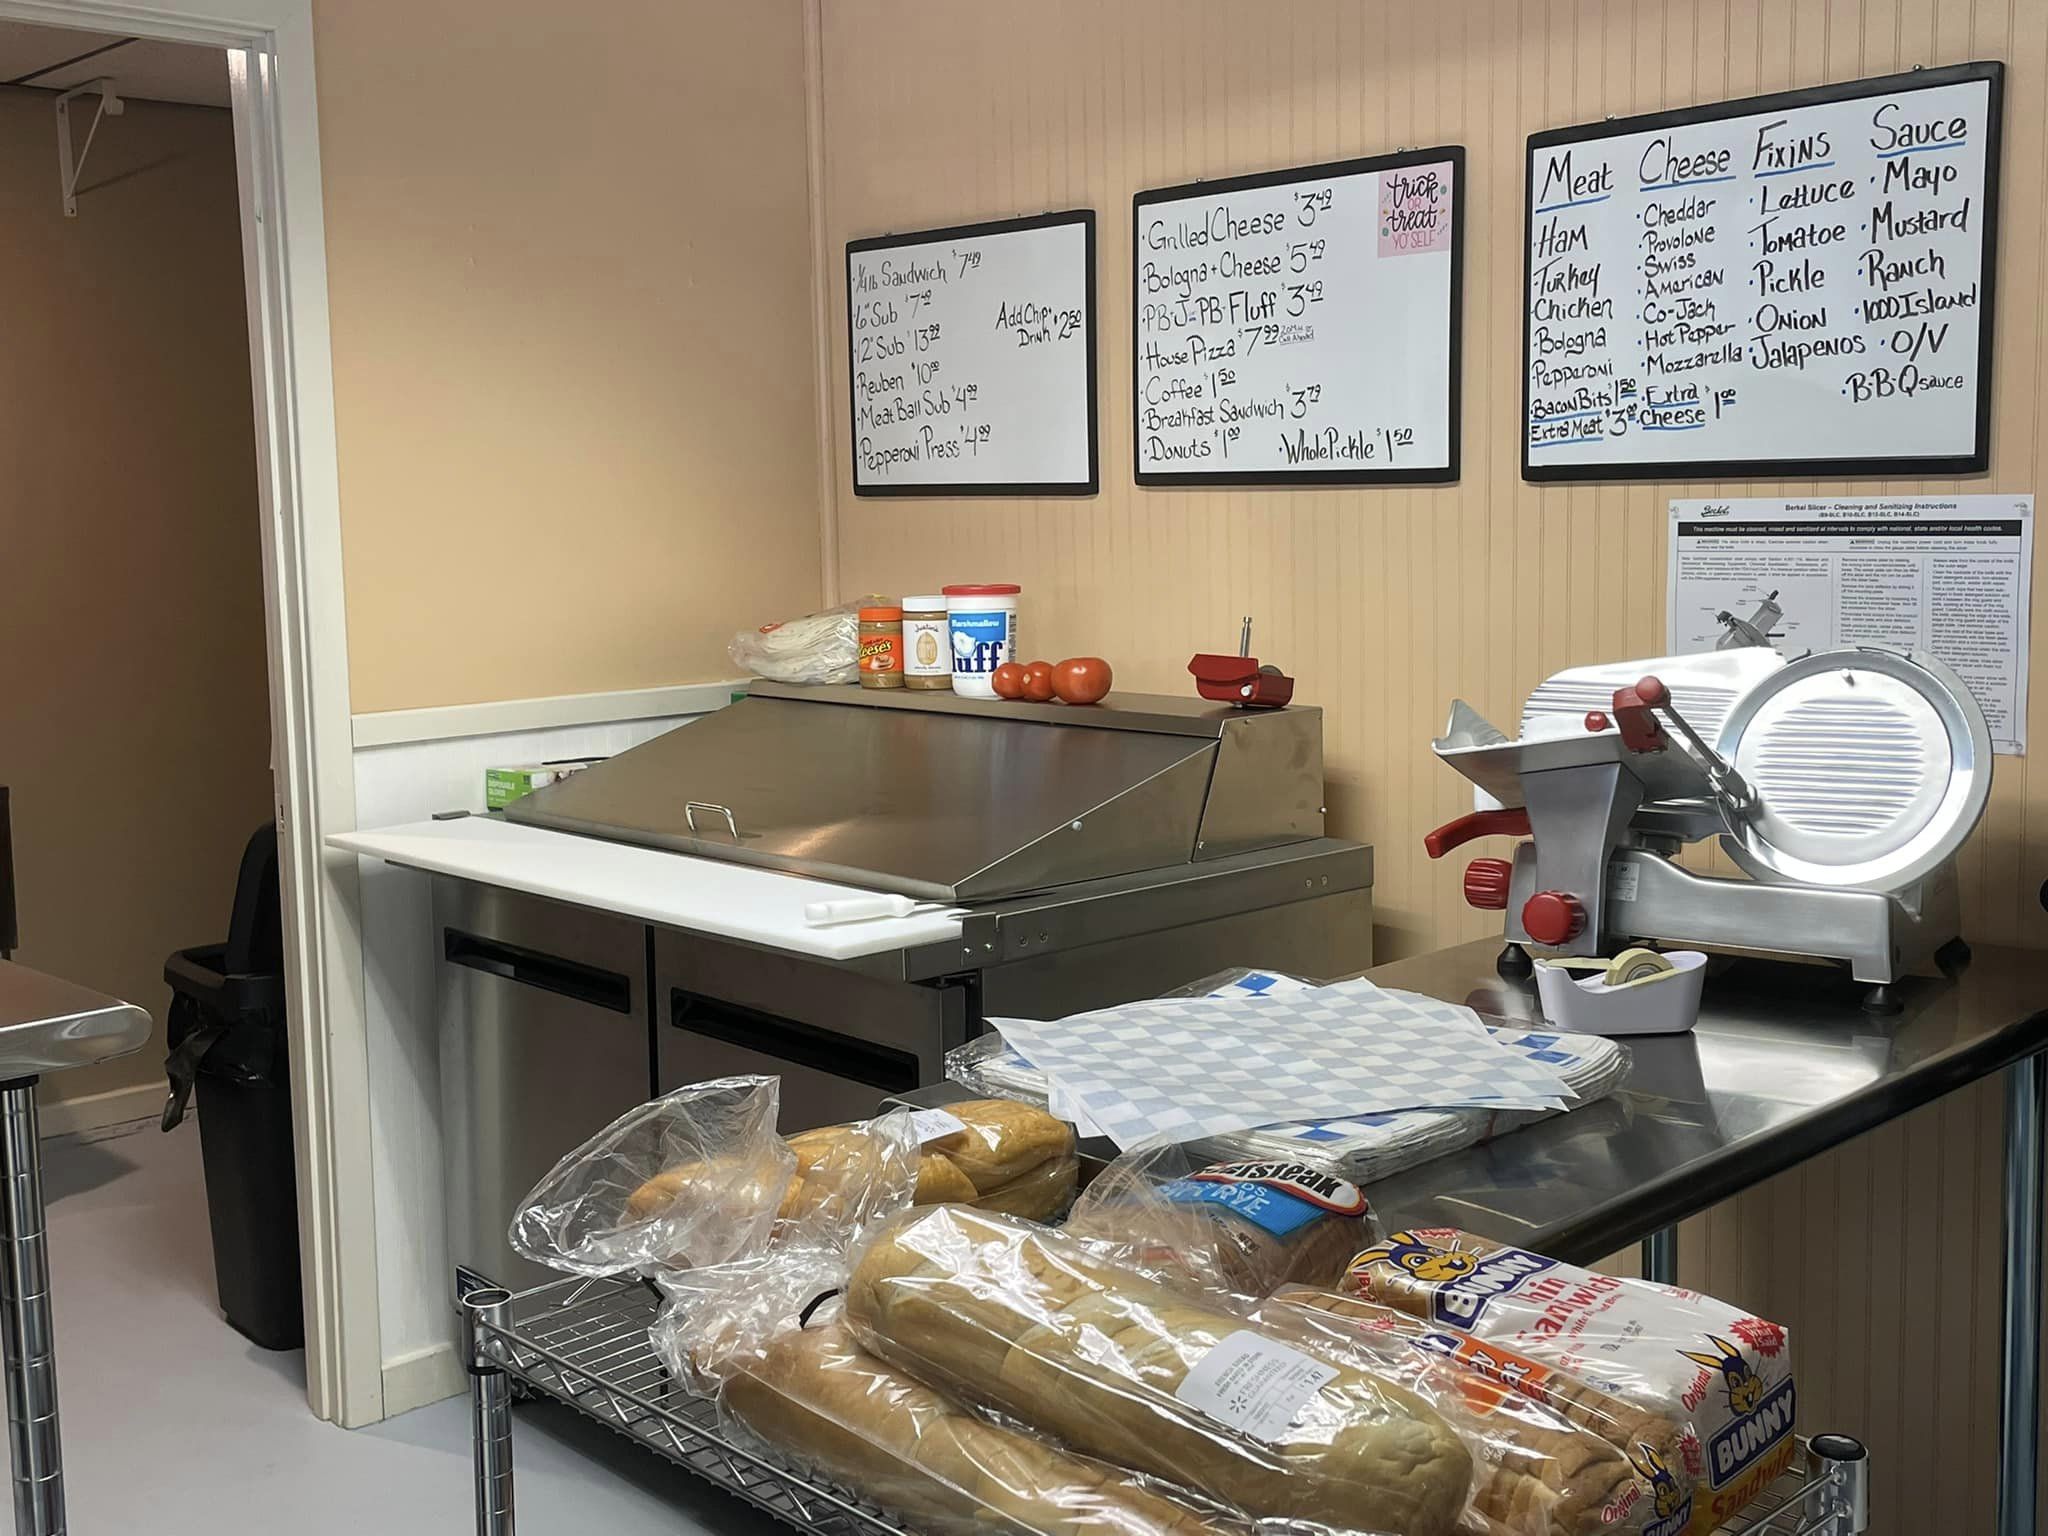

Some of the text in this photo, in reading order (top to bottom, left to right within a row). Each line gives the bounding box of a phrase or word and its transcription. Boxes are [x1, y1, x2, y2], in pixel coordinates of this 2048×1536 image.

[1870, 103, 1967, 150] Sauce
[1640, 136, 1731, 184] Cheese
[1752, 120, 1831, 170] Fixins
[1386, 172, 1439, 209] trick
[1540, 150, 1614, 203] Meat
[1883, 157, 1958, 196] Mayo
[1407, 197, 1422, 211] OR
[1643, 195, 1717, 227] Cheddar
[1761, 180, 1856, 215] Lettuce
[1149, 211, 1209, 250] Grilled
[1211, 207, 1285, 242] Cheese
[1386, 205, 1438, 232] treat
[1871, 198, 1970, 244] Mustard
[1538, 216, 1588, 258] Ham
[1642, 225, 1716, 253] Provolone
[1747, 216, 1846, 256] Tomatoe
[882, 260, 948, 286] Sandwich
[1146, 262, 1207, 298] Bologna
[1220, 251, 1281, 278] Cheese
[1533, 256, 1601, 298] Turkey
[1644, 252, 1697, 278] Swiss
[1752, 259, 1825, 297] Pickle
[1859, 248, 1945, 291] Ranch
[1645, 268, 1725, 300] American
[871, 302, 897, 327] Sub
[995, 301, 1022, 330] Add
[1229, 291, 1277, 324] Fluff
[1533, 297, 1613, 321] Chicken
[1643, 298, 1716, 324] Co-Jack
[1898, 282, 1977, 320] Island
[1755, 304, 1827, 332] Onion
[876, 335, 904, 359] Sub
[1146, 342, 1188, 372] House
[1187, 334, 1235, 372] Pizza
[1535, 326, 1607, 357] Bologna
[1645, 323, 1736, 351] Hot Pepper
[1750, 334, 1866, 370] Jalapenos
[1890, 322, 1949, 362] O/V
[1532, 358, 1613, 390] Pepperoni
[1647, 343, 1743, 376] Mozzarella
[858, 372, 904, 401] Reuben
[1146, 376, 1202, 405] Coffee
[1645, 383, 1700, 406] Extra
[1919, 375, 1964, 391] sauce
[860, 405, 895, 430] Meat
[895, 397, 920, 421] Ball
[924, 390, 950, 416] Sub
[1146, 408, 1214, 431] Breakfast
[1220, 400, 1284, 422] Sandwich
[1532, 397, 1577, 420] Bacon
[1576, 386, 1612, 409] Bits
[1639, 408, 1706, 427] Cheese
[1281, 429, 1327, 464] Whole
[1324, 427, 1375, 461] Pickle
[1530, 422, 1569, 443] Extra
[1571, 416, 1603, 439] Meat
[861, 437, 920, 475] Pepperoni
[920, 425, 960, 460] Press
[1148, 436, 1212, 462] Donuts
[1833, 503, 1863, 513] Cleaning
[1864, 503, 1878, 511] and
[1879, 503, 1913, 513] Sanitizing
[1914, 502, 1957, 511] Instructions
[1213, 1183, 1271, 1217] RYE
[1444, 1253, 1546, 1319] BUNNY
[1504, 1276, 1570, 1304] hin
[1680, 1364, 1713, 1413] Original
[1717, 1388, 1793, 1475] BUNNY
[1600, 1478, 1642, 1525] Original
